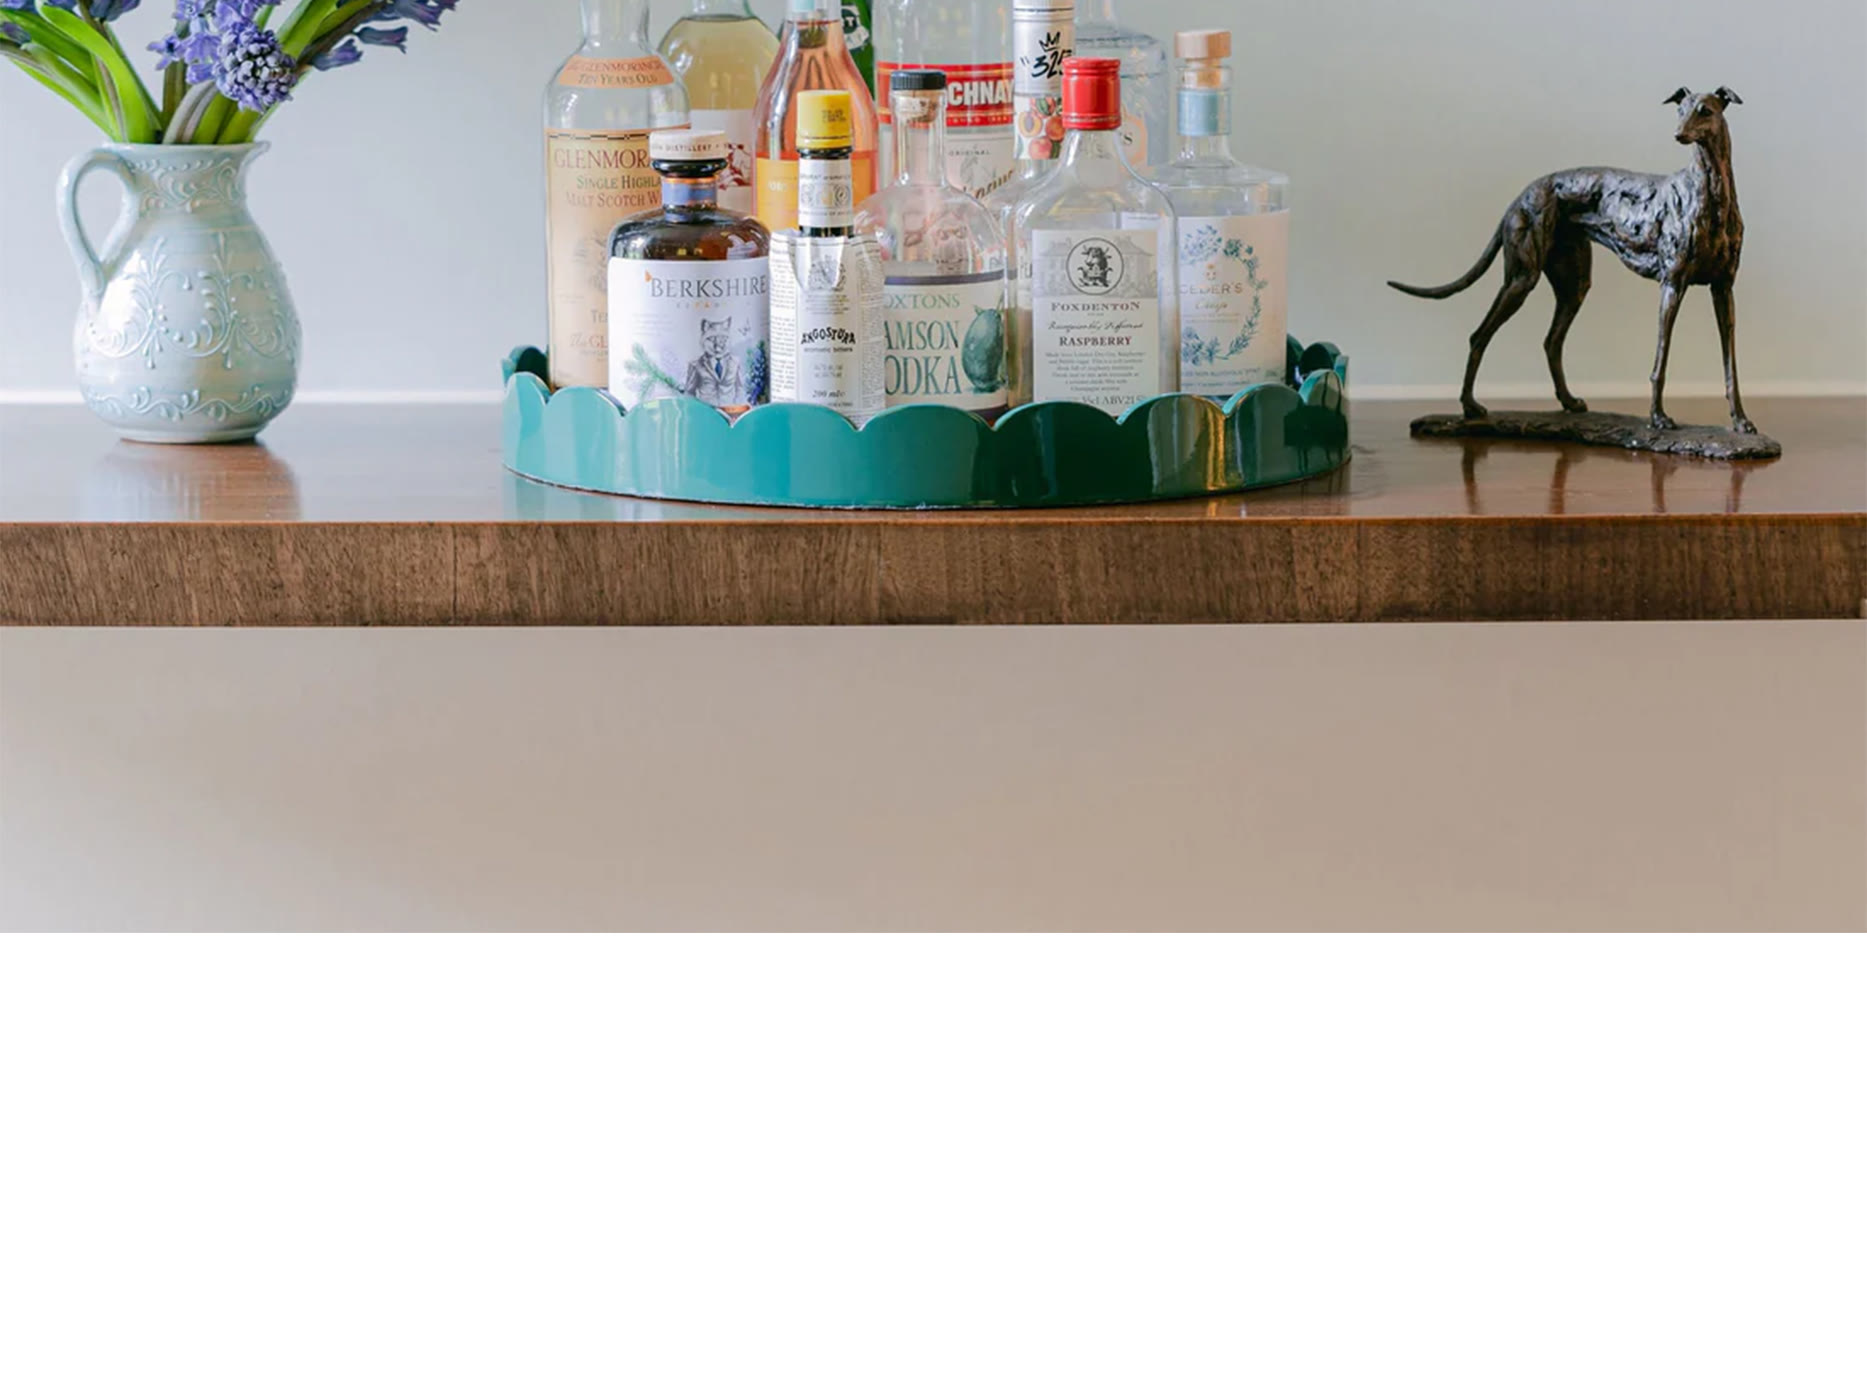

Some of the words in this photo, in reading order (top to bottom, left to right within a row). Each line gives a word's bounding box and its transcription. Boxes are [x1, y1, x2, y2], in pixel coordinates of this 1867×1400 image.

[554, 149, 650, 170] GLENMOR
[576, 175, 618, 189] SINGLE
[596, 190, 646, 207] SCOTCH
[651, 274, 767, 299] BERKSHIRE
[1051, 301, 1141, 311] FOXDENTON
[800, 326, 857, 345] ANGOSTURA
[1059, 336, 1131, 347] RASPBERRY
